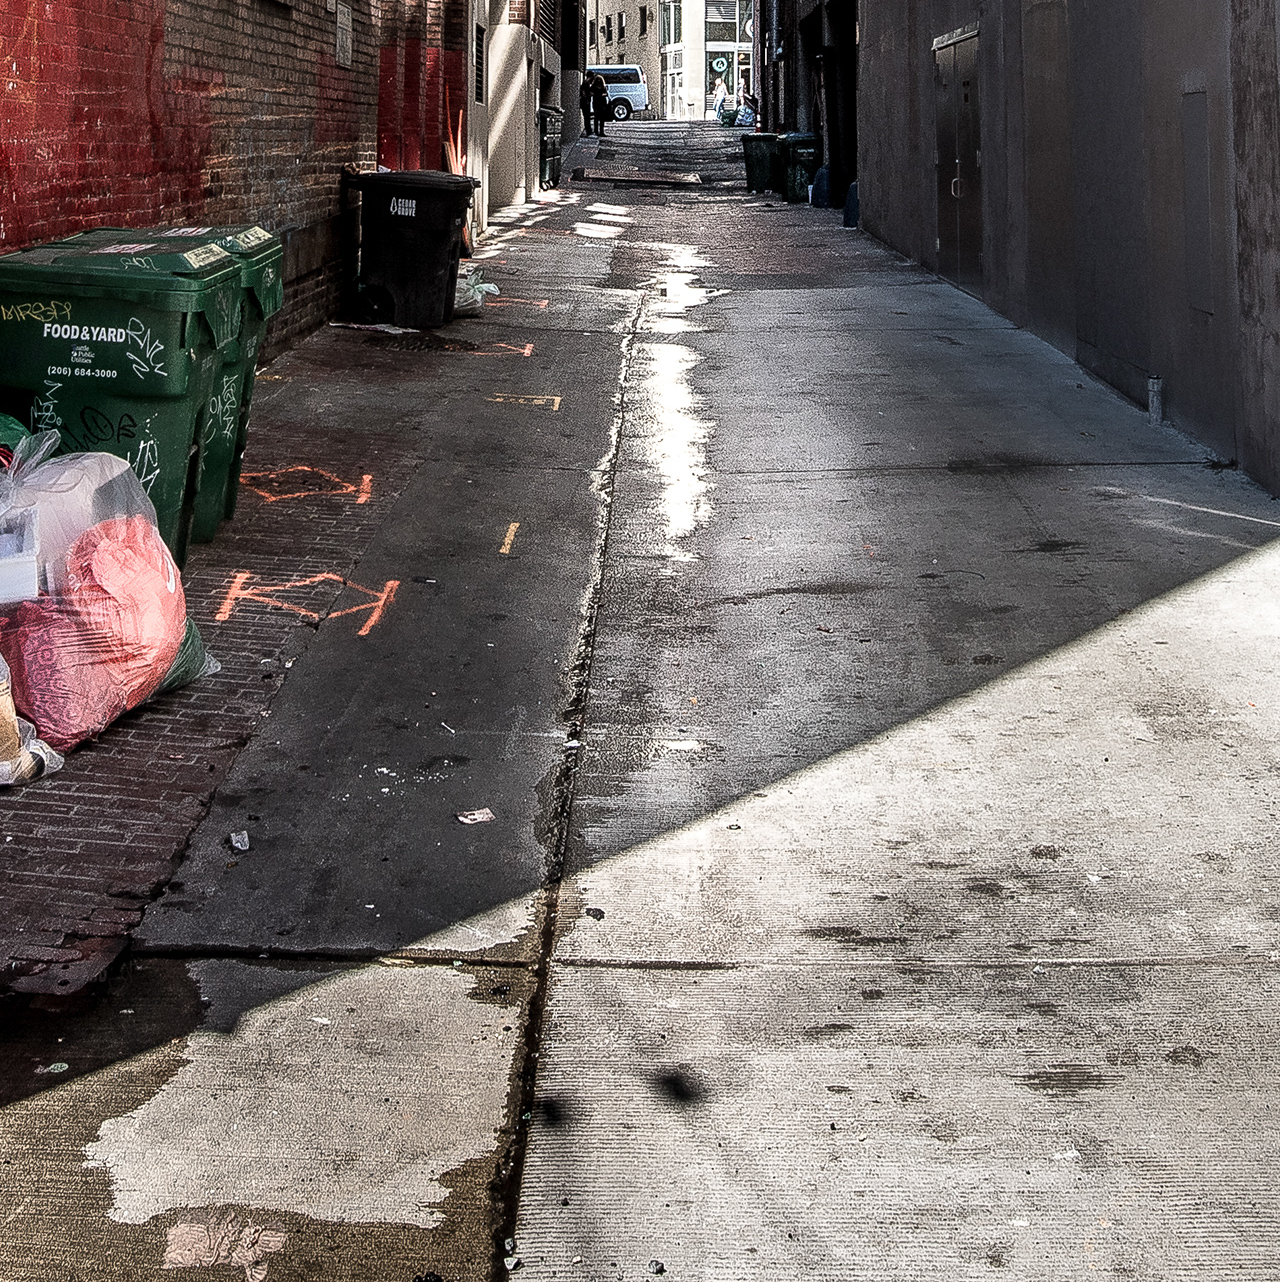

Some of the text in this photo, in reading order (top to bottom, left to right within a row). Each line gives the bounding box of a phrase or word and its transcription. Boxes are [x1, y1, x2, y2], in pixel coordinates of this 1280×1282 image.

[398, 199, 416, 208] CEDAR
[398, 208, 416, 217] GROVE
[47, 366, 118, 378] (206) 684-3000
